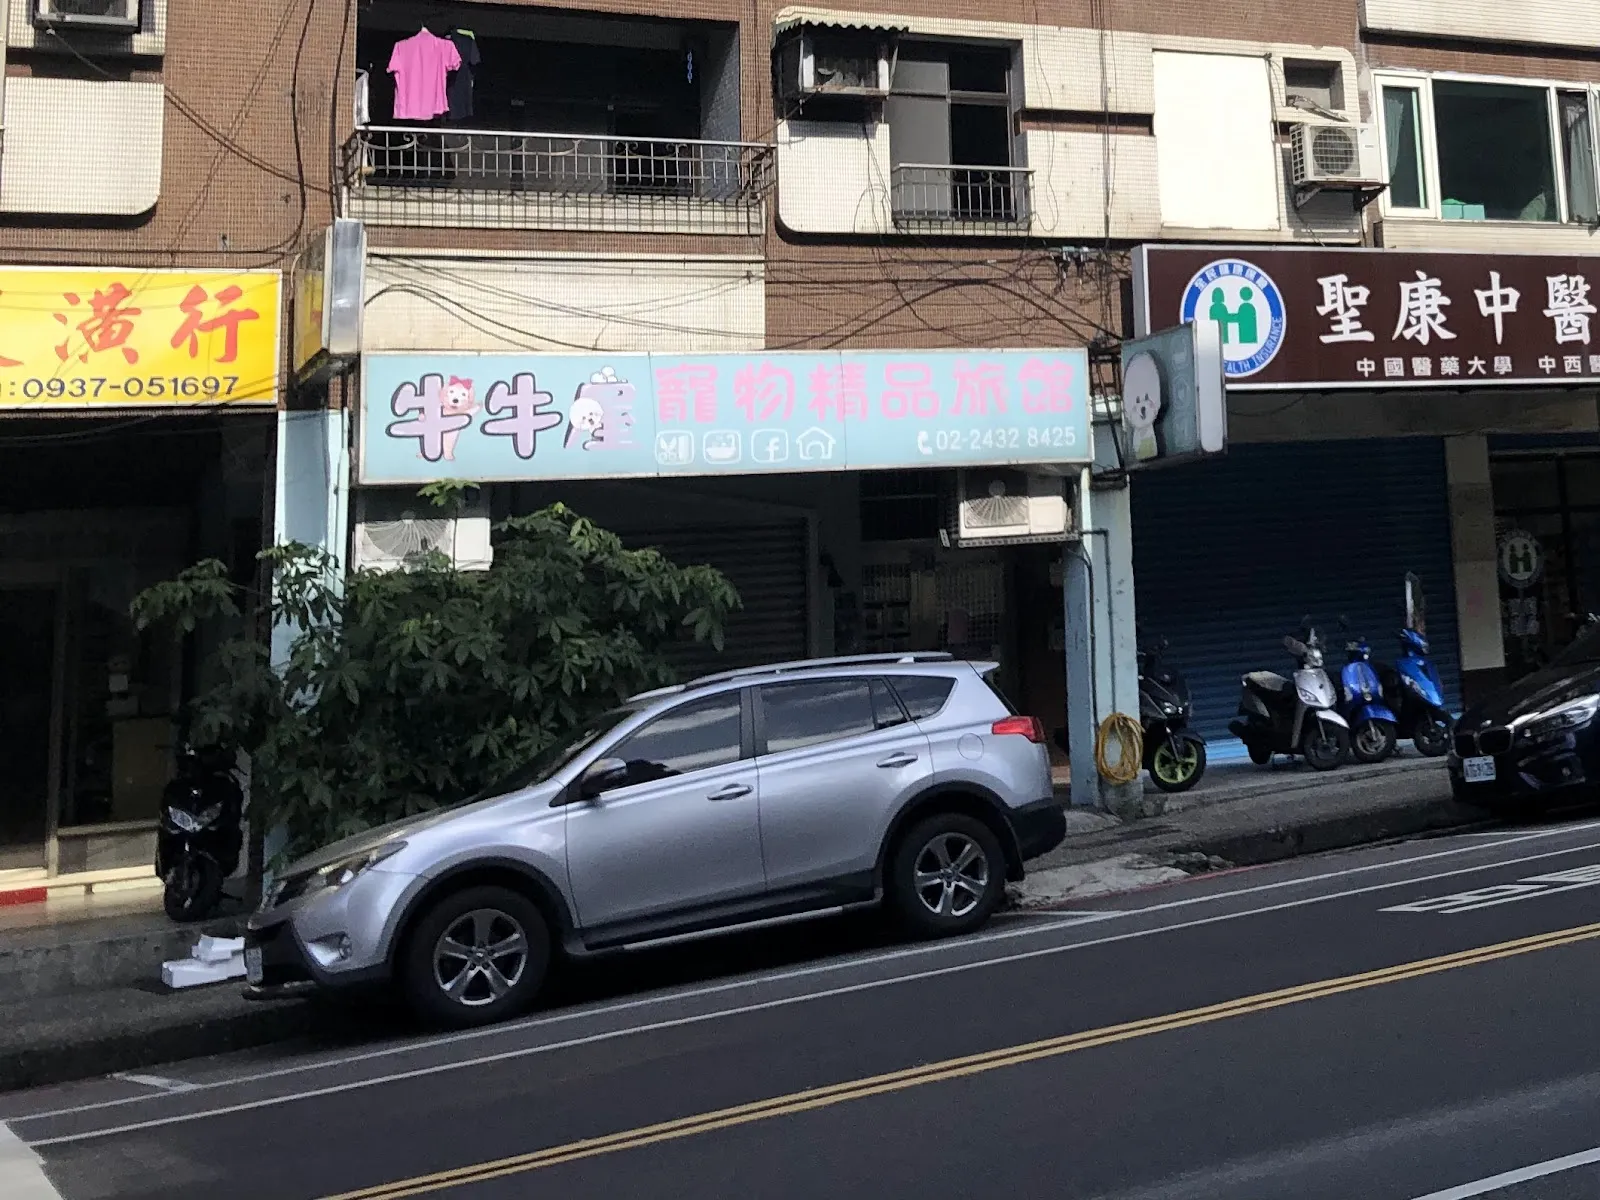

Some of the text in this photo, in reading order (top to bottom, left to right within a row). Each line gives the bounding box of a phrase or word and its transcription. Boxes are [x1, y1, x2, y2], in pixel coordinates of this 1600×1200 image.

[0, 282, 260, 366] 潢行
[1316, 270, 1597, 346] 聖康中醫
[1356, 355, 1513, 378] 中國醫藥大學
[936, 426, 1076, 450] 02-2432 8425
